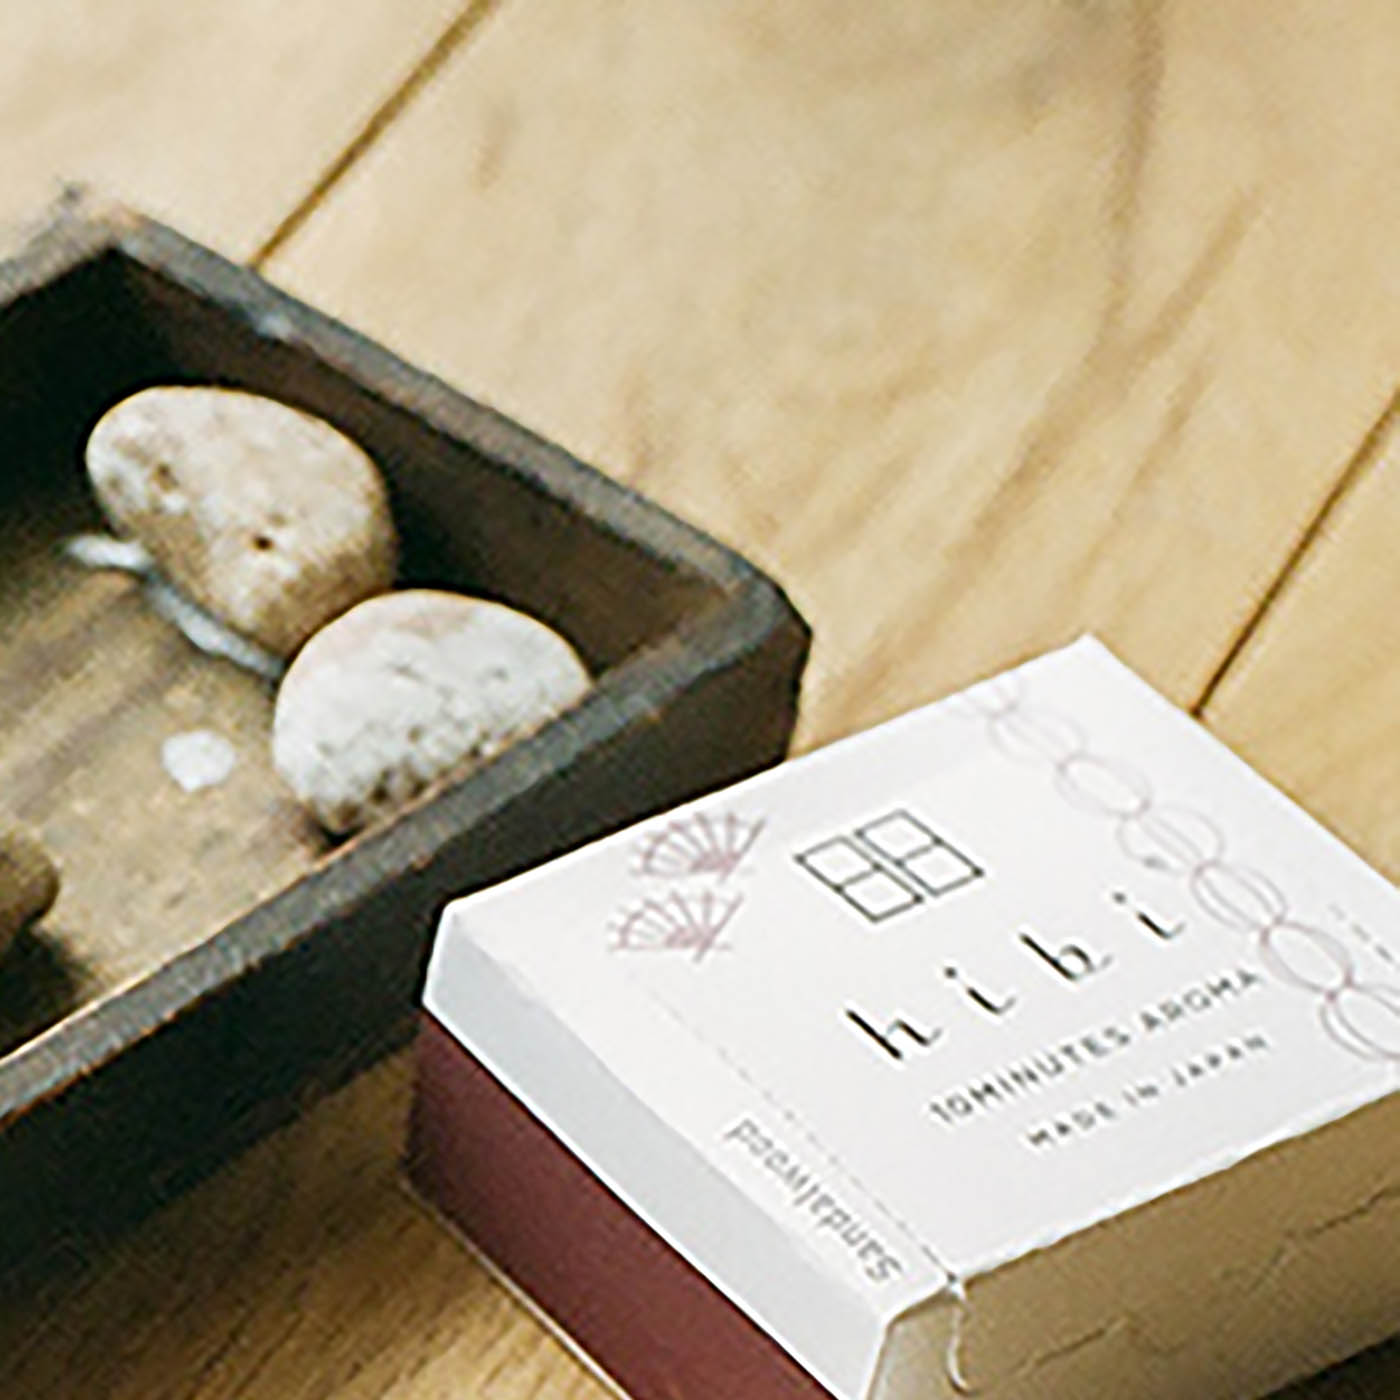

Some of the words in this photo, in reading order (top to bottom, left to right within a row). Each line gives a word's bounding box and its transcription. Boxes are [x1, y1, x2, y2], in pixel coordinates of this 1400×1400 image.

[844, 890, 1186, 1060] hibi
[928, 1026, 1132, 1123] 10MINUTES
[1139, 966, 1262, 1034] AROMA
[1026, 1101, 1117, 1147] MADE
[1121, 1083, 1160, 1108] IN
[1170, 1034, 1269, 1087] JAPAN
[722, 1117, 904, 1284] Sandalwood
